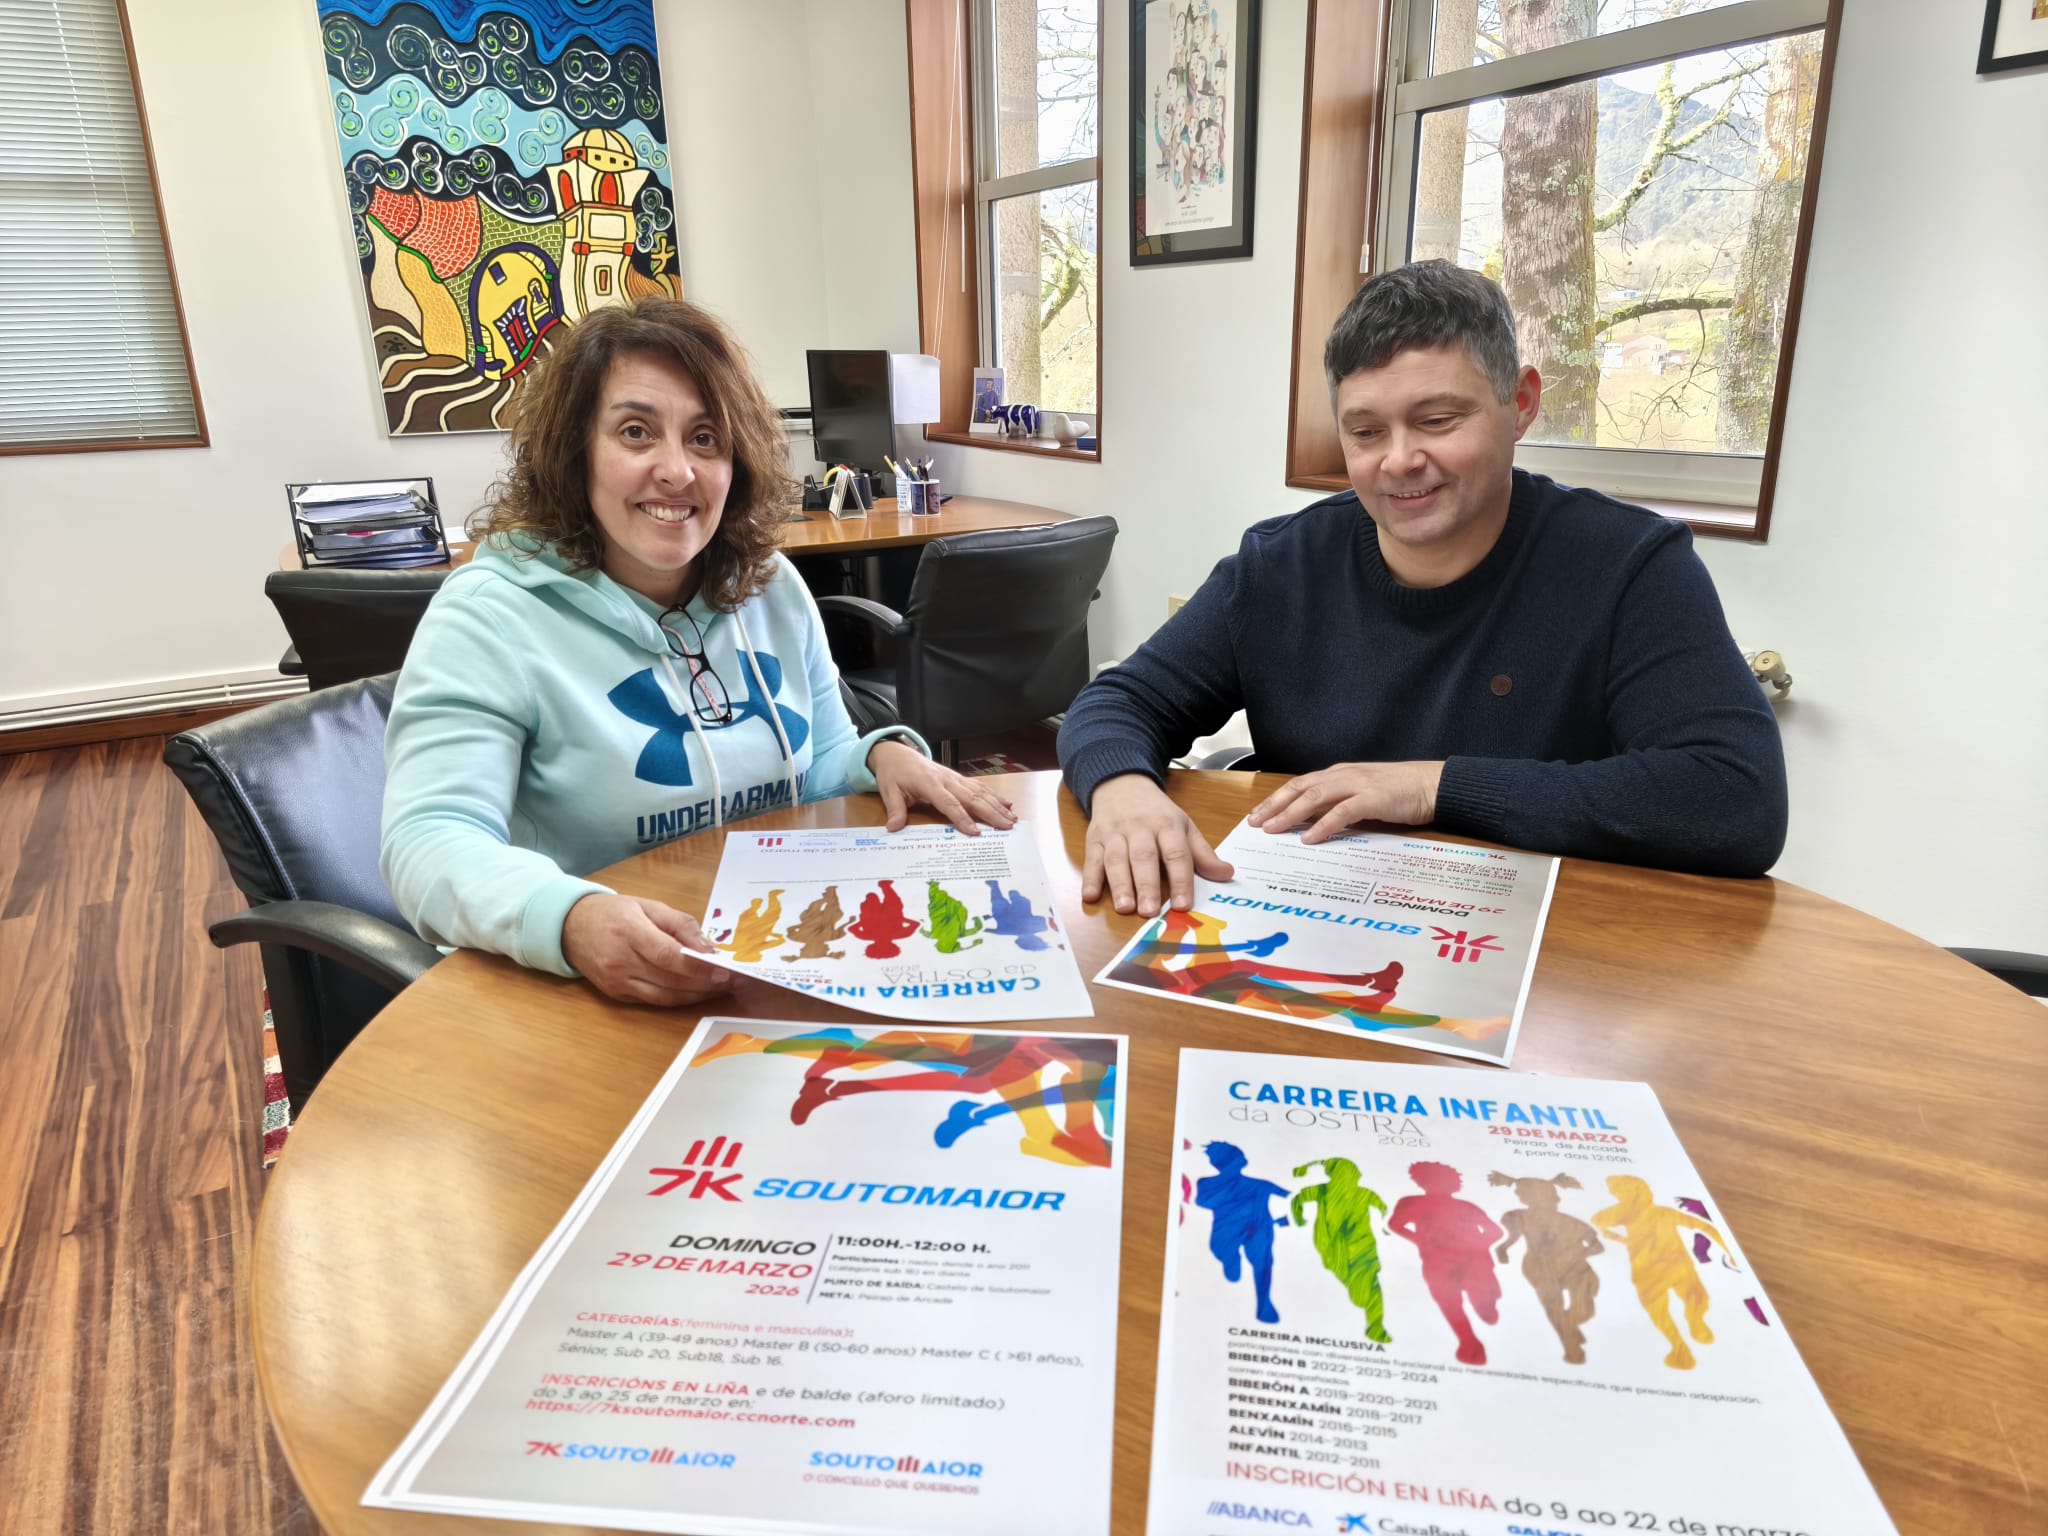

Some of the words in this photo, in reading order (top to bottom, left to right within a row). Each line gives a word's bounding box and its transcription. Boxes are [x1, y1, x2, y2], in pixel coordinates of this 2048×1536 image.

[1375, 889, 1447, 906] MARZO
[1381, 884, 1415, 894] 2026
[1208, 893, 1422, 937] SOUTOMAIOR
[1373, 897, 1470, 917] DOMINGO
[1450, 900, 1476, 910] DE
[1478, 905, 1506, 914] 29
[1429, 925, 1505, 951] 7K
[881, 967, 991, 984] OSTRA
[1003, 963, 1036, 975] da
[877, 976, 1040, 998] CARREIRA
[1229, 1080, 1429, 1116] CARREIRA
[1438, 1096, 1619, 1130] INFANTIL
[1228, 1104, 1269, 1123] da
[1285, 1108, 1425, 1137] OSTRA
[1377, 1134, 1431, 1148] 2026
[1488, 1124, 1512, 1135] 29
[1516, 1126, 1542, 1138] DE
[1547, 1128, 1628, 1144] MARZO
[1554, 1141, 1572, 1150] de
[646, 1167, 744, 1203] 7K
[752, 1178, 1067, 1212] SOUTOMAIOR
[668, 1235, 817, 1256] DOMINGO
[605, 1252, 653, 1269] 29
[653, 1255, 698, 1272] DE
[697, 1258, 814, 1279] MARZO
[744, 1283, 800, 1297] 2026
[824, 1277, 864, 1286] PUNTO
[866, 1279, 882, 1287] DE
[567, 1326, 617, 1339] Master
[621, 1329, 634, 1340] A
[638, 1330, 692, 1344] (39-49
[743, 1336, 791, 1349] Master
[798, 1340, 810, 1351] B
[814, 1340, 869, 1355] (50-60
[920, 1346, 973, 1359] Master
[977, 1349, 990, 1360] C
[1228, 1327, 1301, 1342] CARREIRA
[1304, 1335, 1387, 1352] INCLUSIVA
[613, 1345, 644, 1358] Sub
[731, 1352, 761, 1365] Sub
[1227, 1350, 1294, 1366] BIBERÓN
[1296, 1359, 1307, 1368] B
[541, 1372, 666, 1390] INSCRICIÓNS
[671, 1380, 699, 1392] EN
[704, 1380, 749, 1395] LIÑA
[754, 1387, 766, 1397] e
[772, 1386, 795, 1398] de
[800, 1387, 852, 1401] balde
[857, 1390, 916, 1406] (aforo
[920, 1394, 1006, 1411] limitado)
[1227, 1376, 1295, 1393] BIBERÓN
[1298, 1385, 1309, 1395] A
[532, 1385, 557, 1398] do
[561, 1386, 575, 1399] 3
[578, 1389, 602, 1401] ao
[606, 1389, 630, 1402] 25
[635, 1391, 659, 1404] de
[663, 1394, 722, 1407] marzo
[1228, 1392, 1341, 1414] PREBENXAMÍN
[1228, 1408, 1314, 1426] BENXAMÍN
[1229, 1423, 1285, 1439] ALEVÍN
[1228, 1441, 1299, 1458] INFANTIL
[1226, 1460, 1386, 1496] INSCRICIÓN
[1394, 1481, 1429, 1502] EN
[1437, 1487, 1498, 1511] LIÑA
[1504, 1496, 1542, 1517] do
[1550, 1501, 1569, 1520] 9
[1577, 1508, 1617, 1526] ao
[1624, 1510, 1661, 1531] 22
[1668, 1516, 1708, 1536] de
